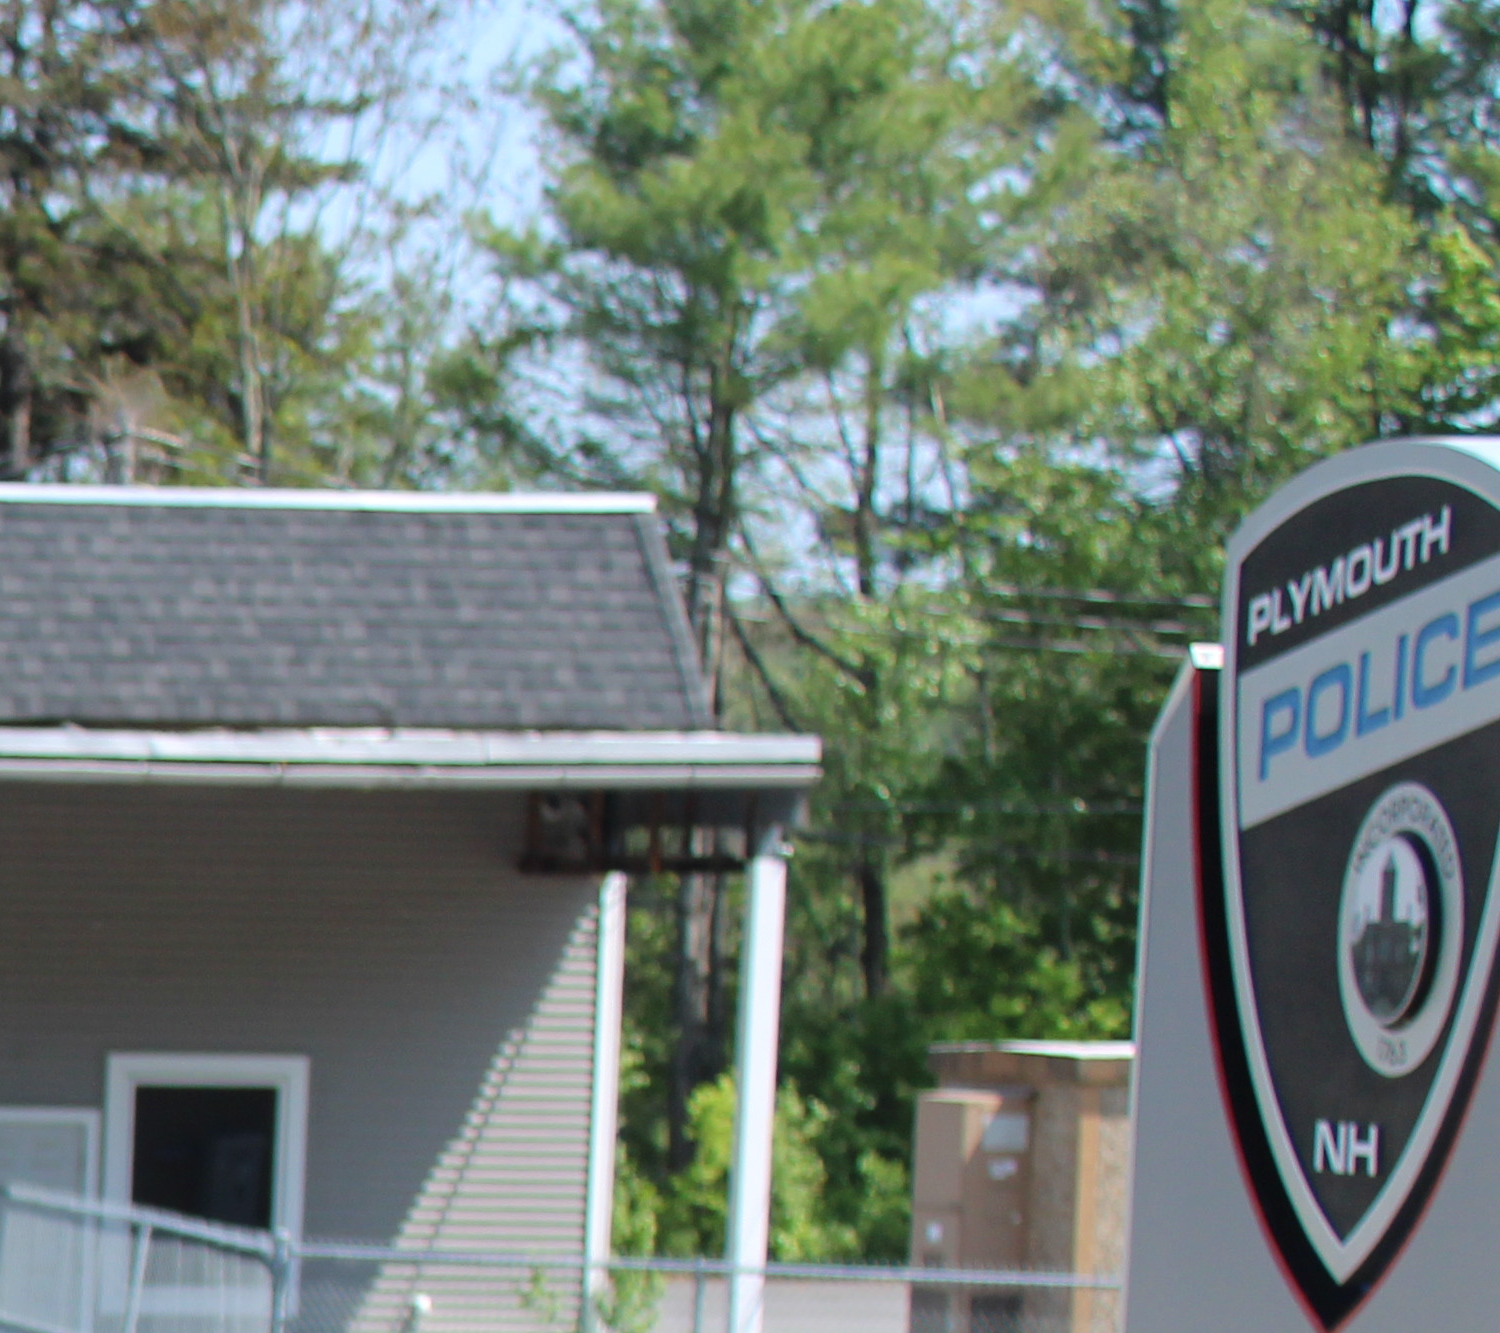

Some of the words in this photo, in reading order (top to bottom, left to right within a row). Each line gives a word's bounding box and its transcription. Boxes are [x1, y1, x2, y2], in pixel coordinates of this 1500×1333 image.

[1246, 504, 1452, 646] PLYMOUTH
[1259, 590, 1500, 782] POLICE
[1313, 1118, 1380, 1178] NH
